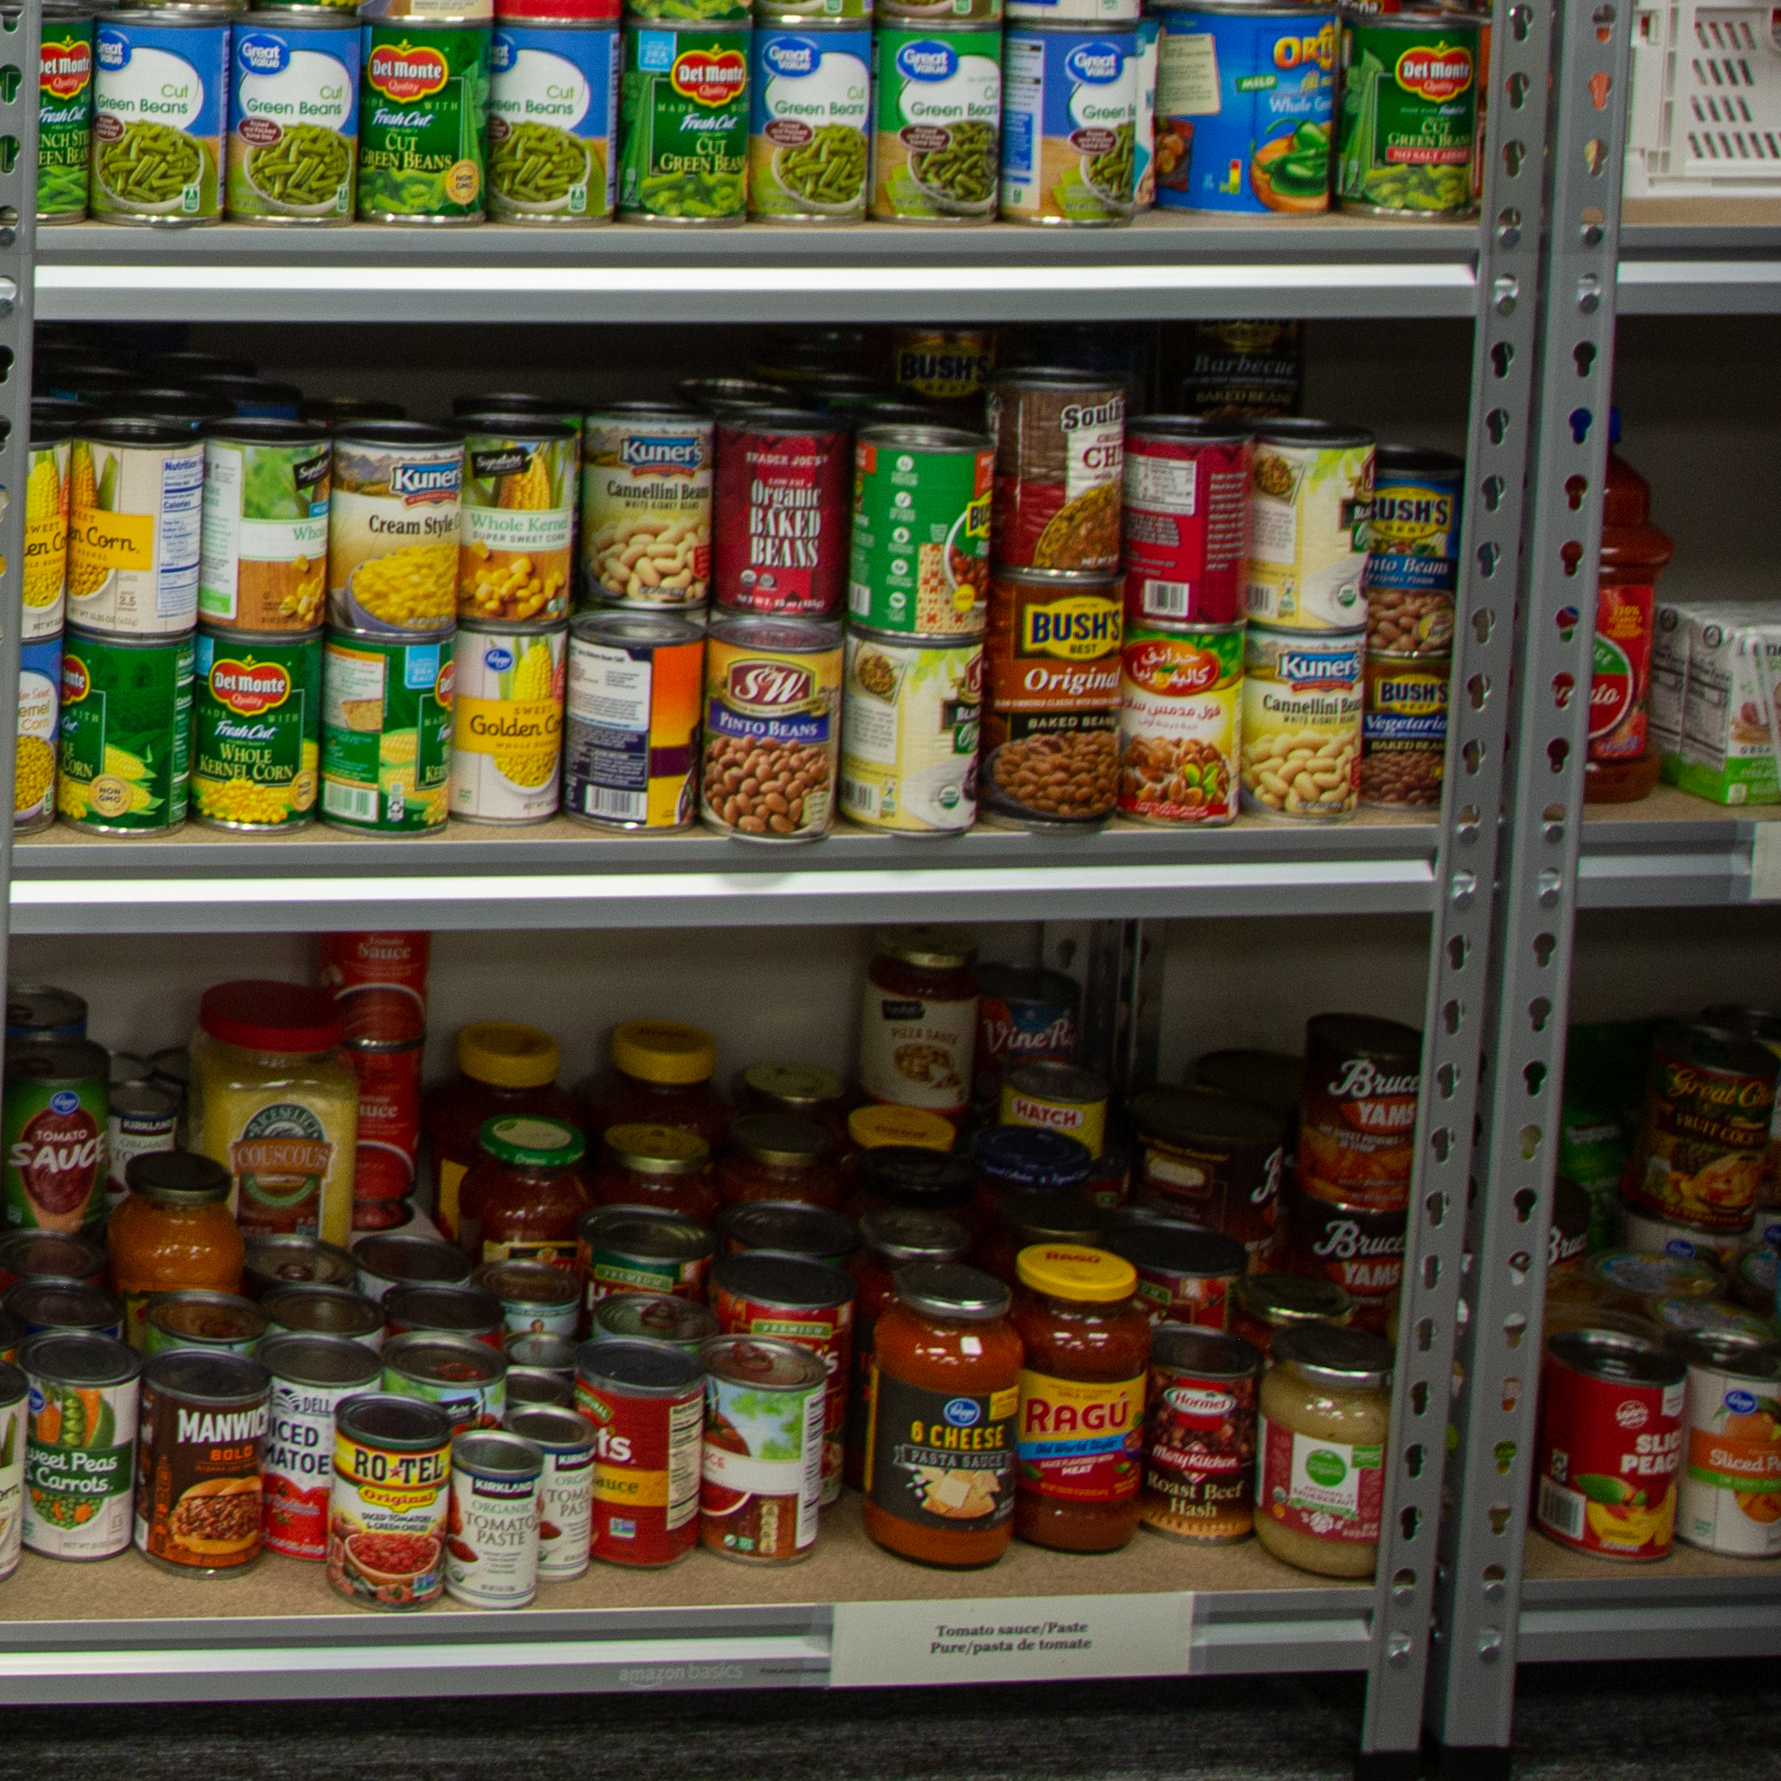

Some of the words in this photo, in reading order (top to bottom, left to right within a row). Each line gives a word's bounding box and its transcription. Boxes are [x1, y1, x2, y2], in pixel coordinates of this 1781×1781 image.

[1241, 76, 1274, 89] MILD
[319, 84, 343, 99] Cut
[247, 98, 286, 114] Green
[289, 100, 343, 116] Beans
[385, 133, 416, 150] CUT
[746, 453, 786, 465] TRADER
[791, 454, 828, 465] JOE'S
[750, 507, 821, 538] BAKED
[751, 539, 819, 568] BEANS
[1032, 611, 1120, 644] BUSH'S
[1069, 643, 1098, 654] BEST
[1356, 1100, 1416, 1127] YAMS
[36, 1130, 88, 1142] TOMATO
[238, 1145, 330, 1170] COUSCOUS
[930, 1425, 1005, 1449] CHEESE
[475, 1480, 534, 1494] KIRKLAND
[1170, 1498, 1218, 1519] Hash
[476, 1530, 525, 1546] PASTE
[936, 1623, 992, 1637] Tomato
[996, 1621, 1088, 1637] sauce/Paste
[930, 1640, 1014, 1656] Pure/pasta
[1017, 1638, 1034, 1652] de
[1038, 1637, 1092, 1652] tomate
